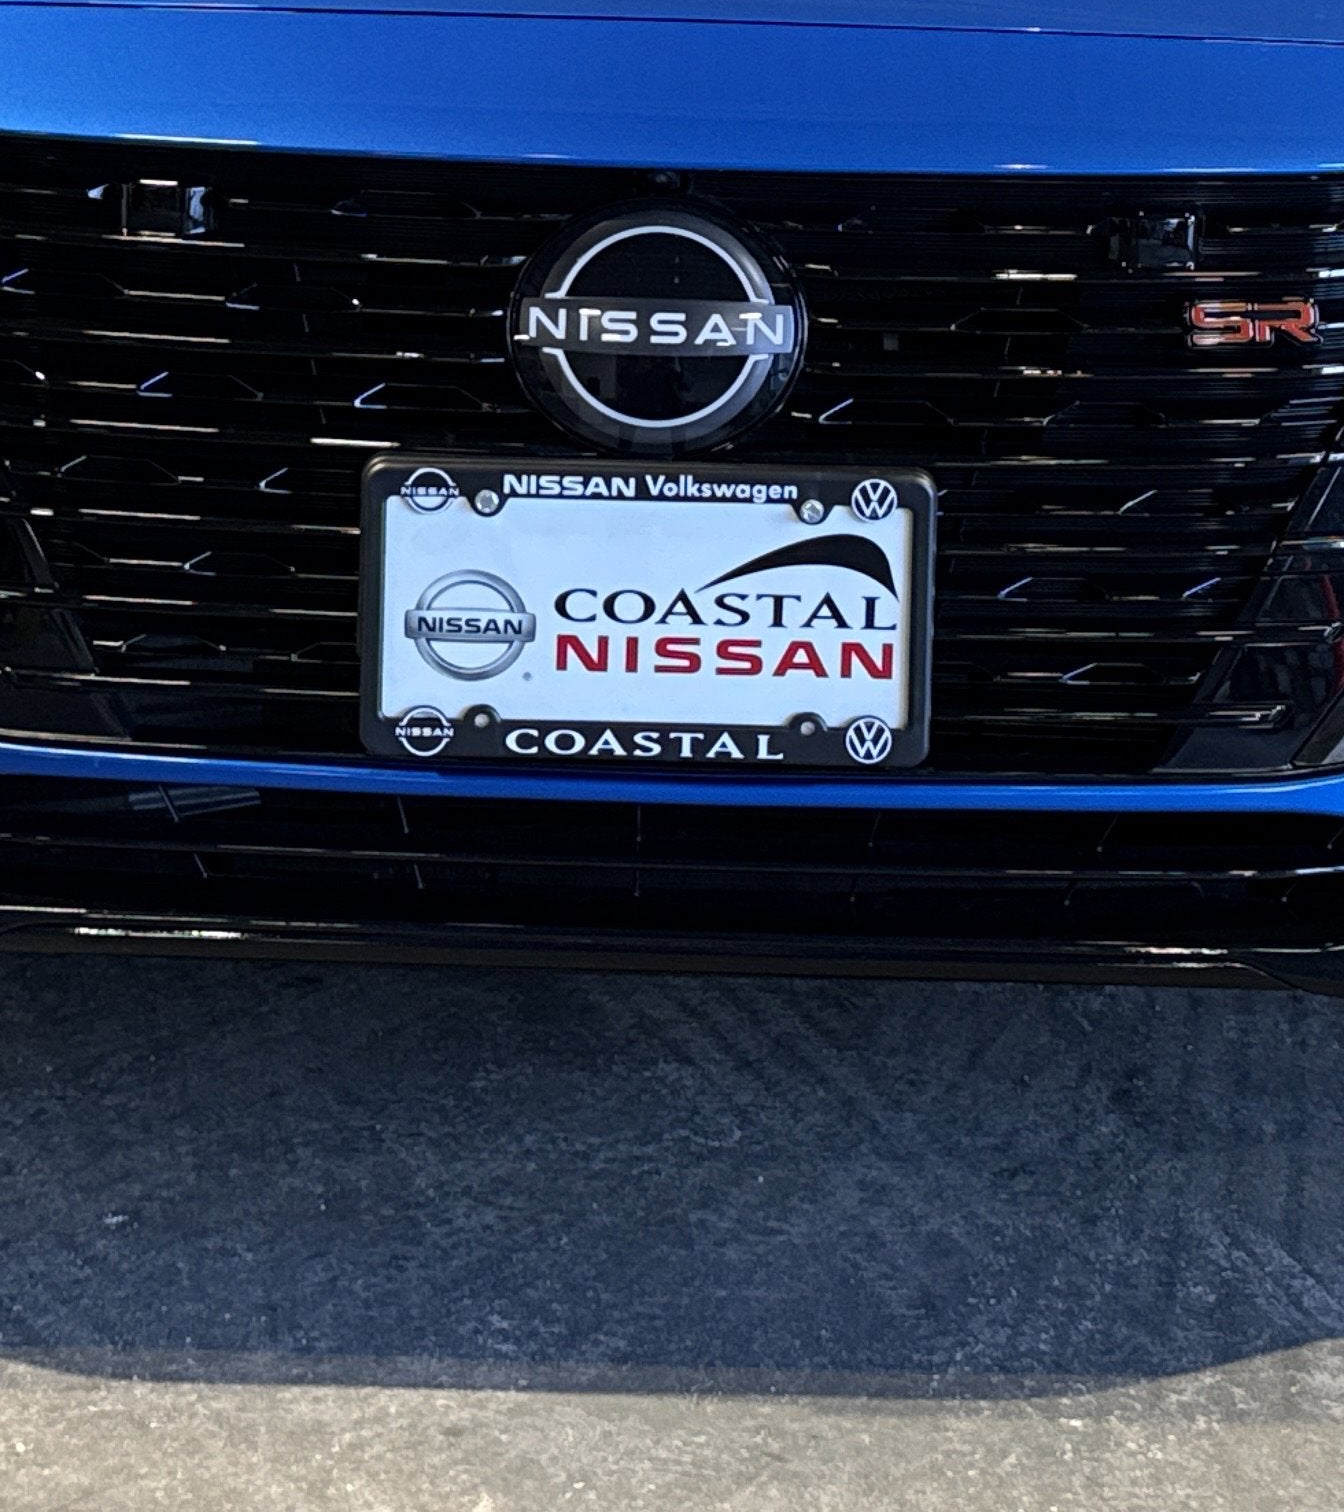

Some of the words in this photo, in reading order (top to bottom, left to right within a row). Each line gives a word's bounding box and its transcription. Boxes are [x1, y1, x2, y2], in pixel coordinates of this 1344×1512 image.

[528, 306, 784, 346] NISSAN
[1190, 301, 1320, 346] SR
[401, 484, 459, 498] NISSAN
[503, 473, 636, 498] NISSAN
[645, 474, 798, 503] Volkswagen
[417, 615, 523, 636] NISSAN
[554, 586, 898, 632] COASTAL
[555, 634, 894, 680] NISSAN
[395, 725, 455, 738] NISSAN
[505, 728, 784, 761] COASTAL
